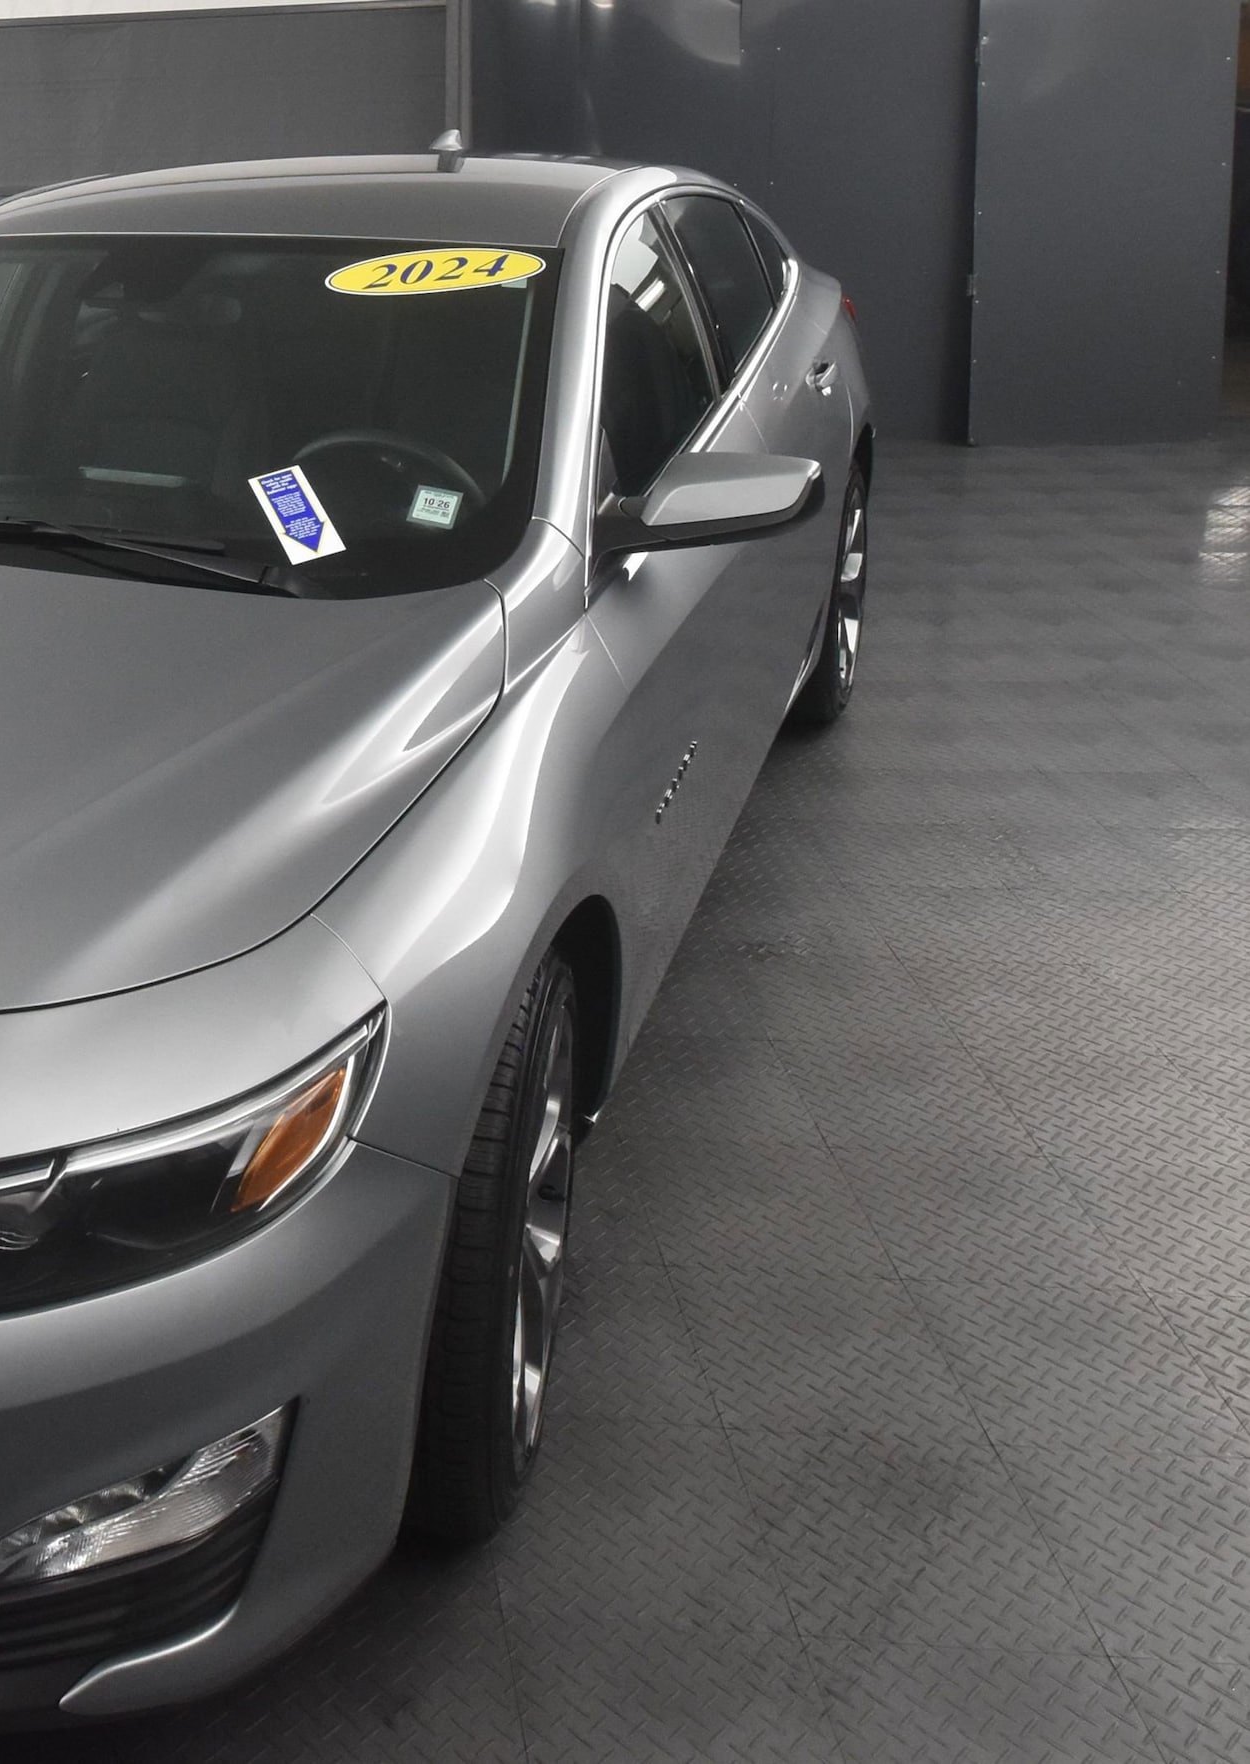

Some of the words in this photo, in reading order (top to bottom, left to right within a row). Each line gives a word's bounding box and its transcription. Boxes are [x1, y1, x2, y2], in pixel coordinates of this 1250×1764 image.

[362, 254, 510, 289] 2024
[424, 497, 435, 506] 10
[437, 500, 450, 509] 26
